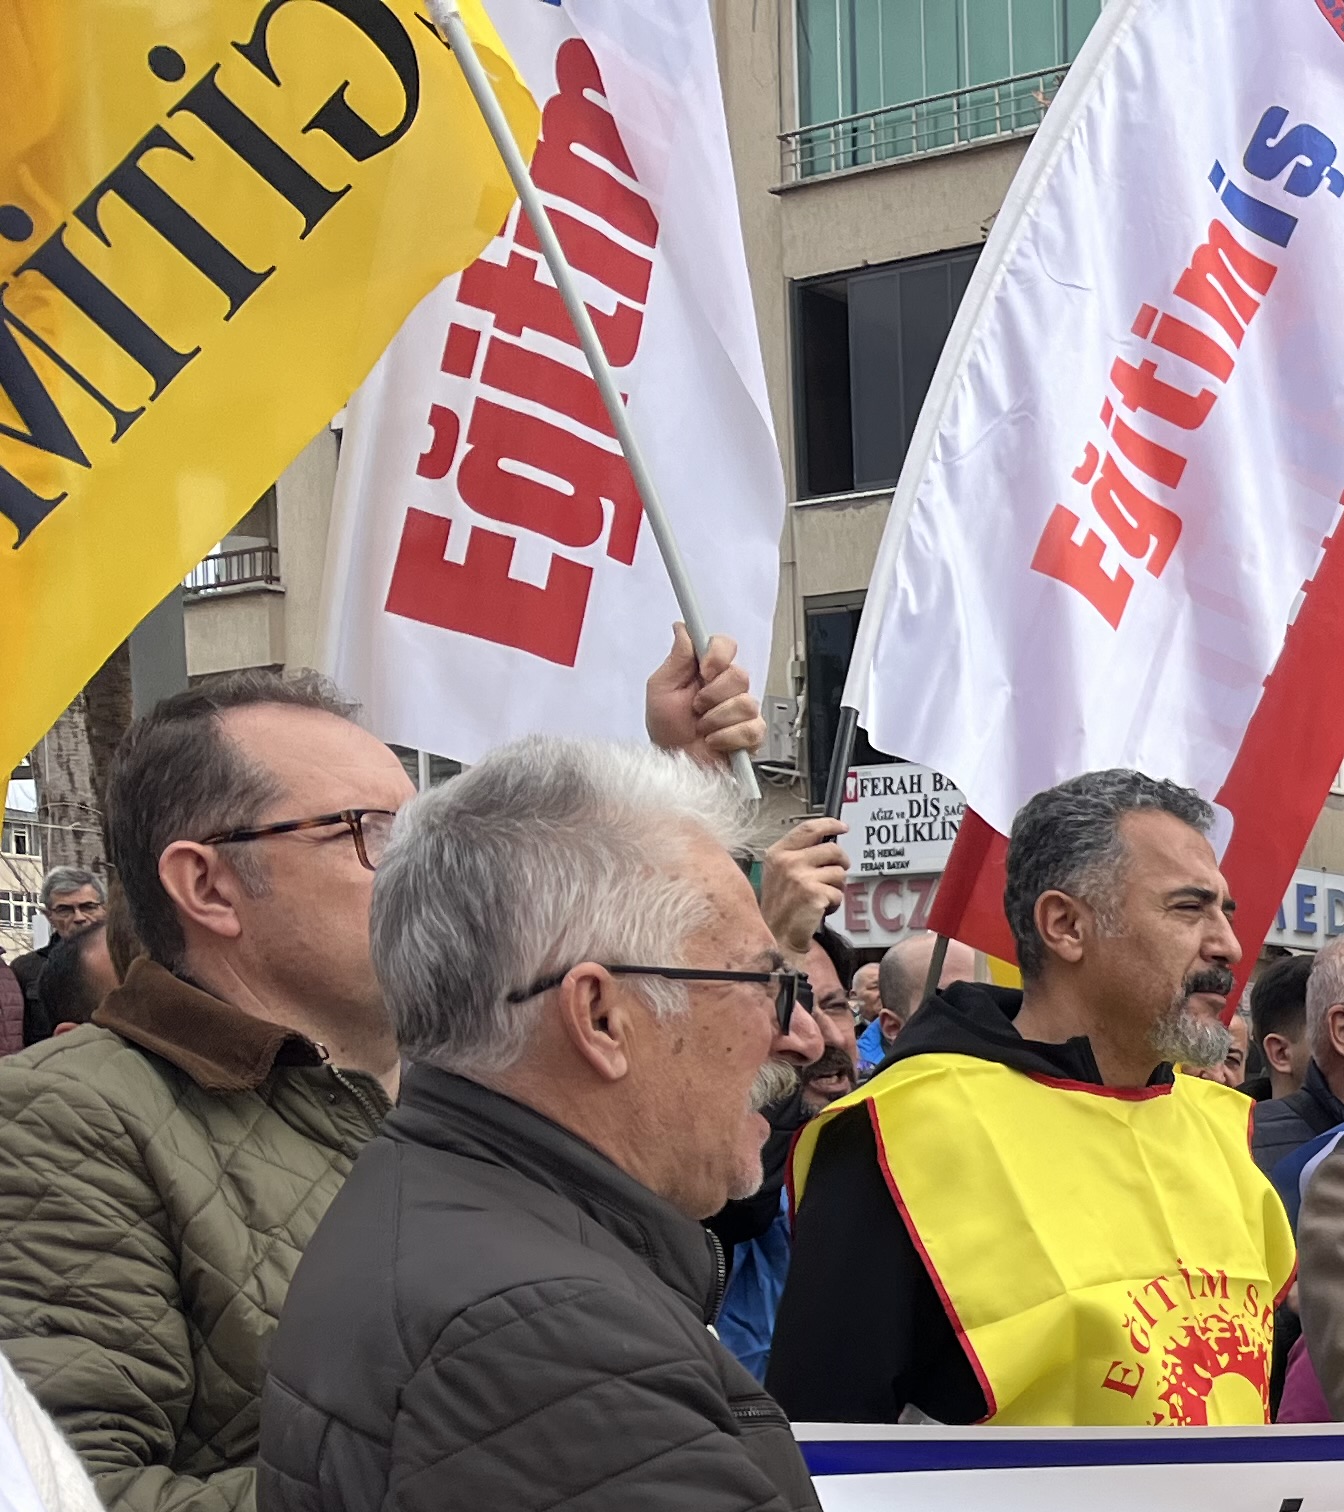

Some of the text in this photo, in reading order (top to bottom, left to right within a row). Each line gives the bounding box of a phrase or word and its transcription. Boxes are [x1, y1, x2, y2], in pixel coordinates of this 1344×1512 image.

[859, 773, 958, 797] FERAH BA
[870, 808, 894, 821] AĞIZ
[908, 793, 940, 822] DİŞ
[943, 802, 967, 817] SAĞ
[865, 816, 962, 846] POLİKLİN
[844, 877, 941, 932] ECZ
[1101, 1258, 1274, 1400] EĞİTİM SE
